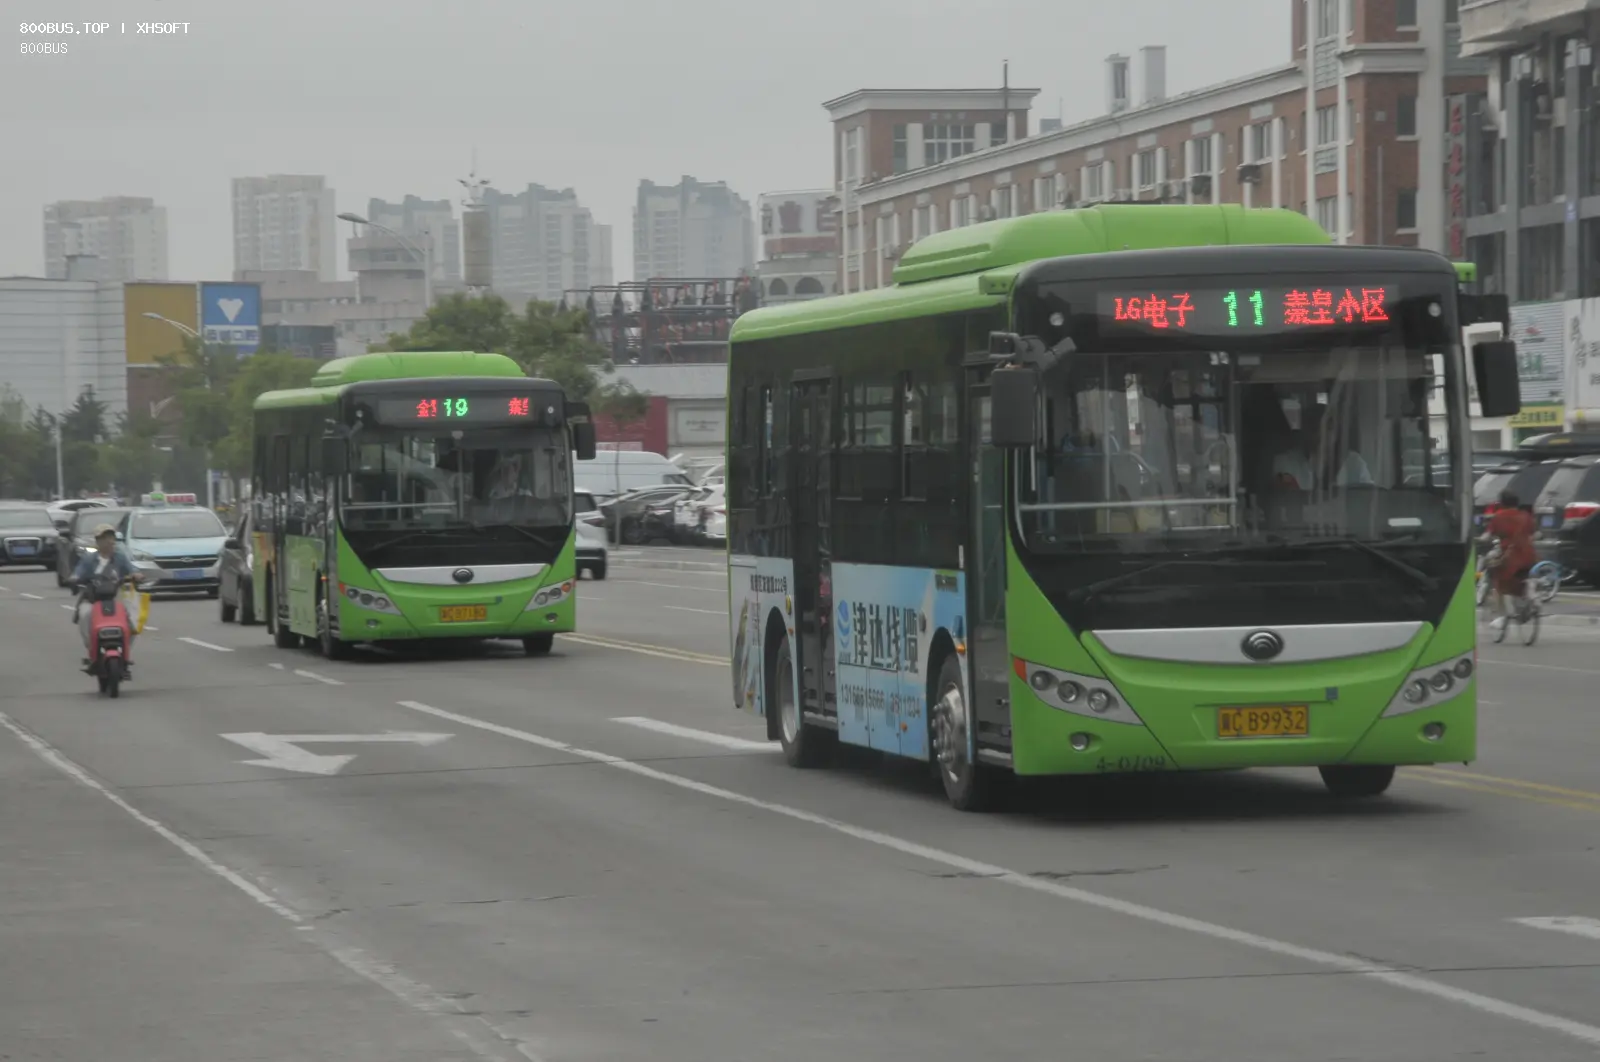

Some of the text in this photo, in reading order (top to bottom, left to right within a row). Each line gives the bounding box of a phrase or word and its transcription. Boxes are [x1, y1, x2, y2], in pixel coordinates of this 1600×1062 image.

[1113, 287, 1389, 328] LG电子 11 秦皇小区
[442, 397, 469, 417] 19
